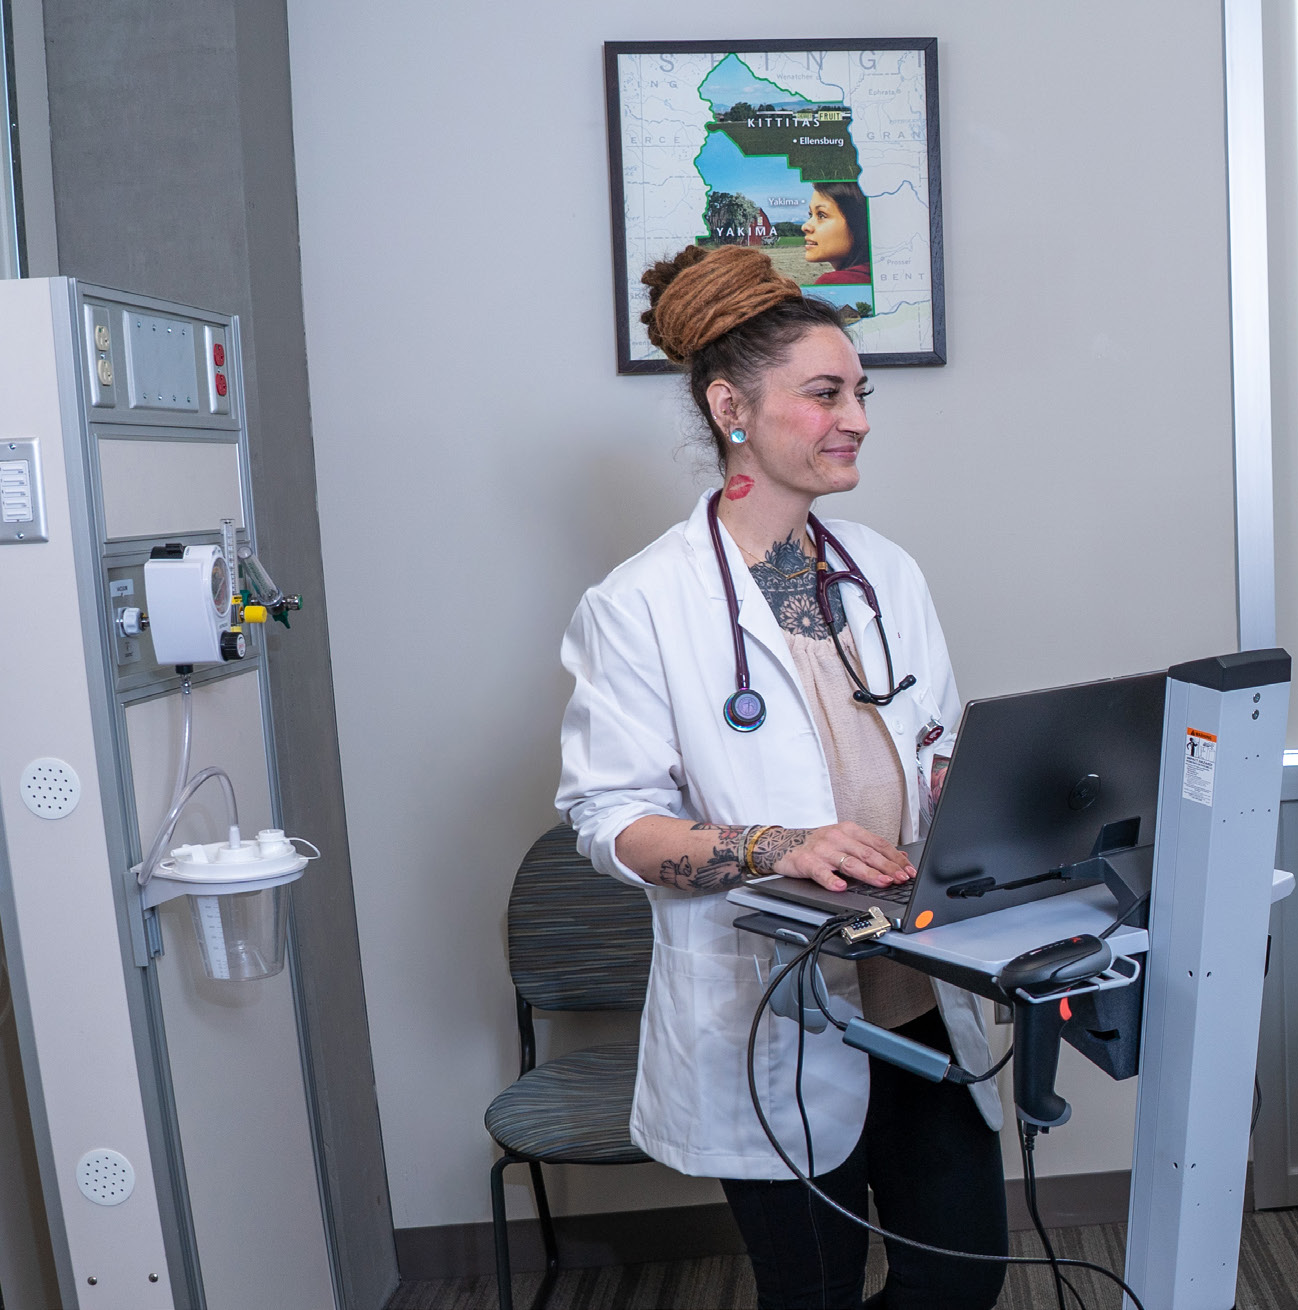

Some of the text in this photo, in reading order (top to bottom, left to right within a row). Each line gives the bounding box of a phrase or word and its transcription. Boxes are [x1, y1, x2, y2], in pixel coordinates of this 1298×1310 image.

[819, 112, 841, 120] FRUIT
[747, 117, 820, 128] KITTITAS
[799, 136, 844, 147] Ellensburg
[768, 197, 799, 206] Yakima
[716, 226, 778, 236] YAKIMA
